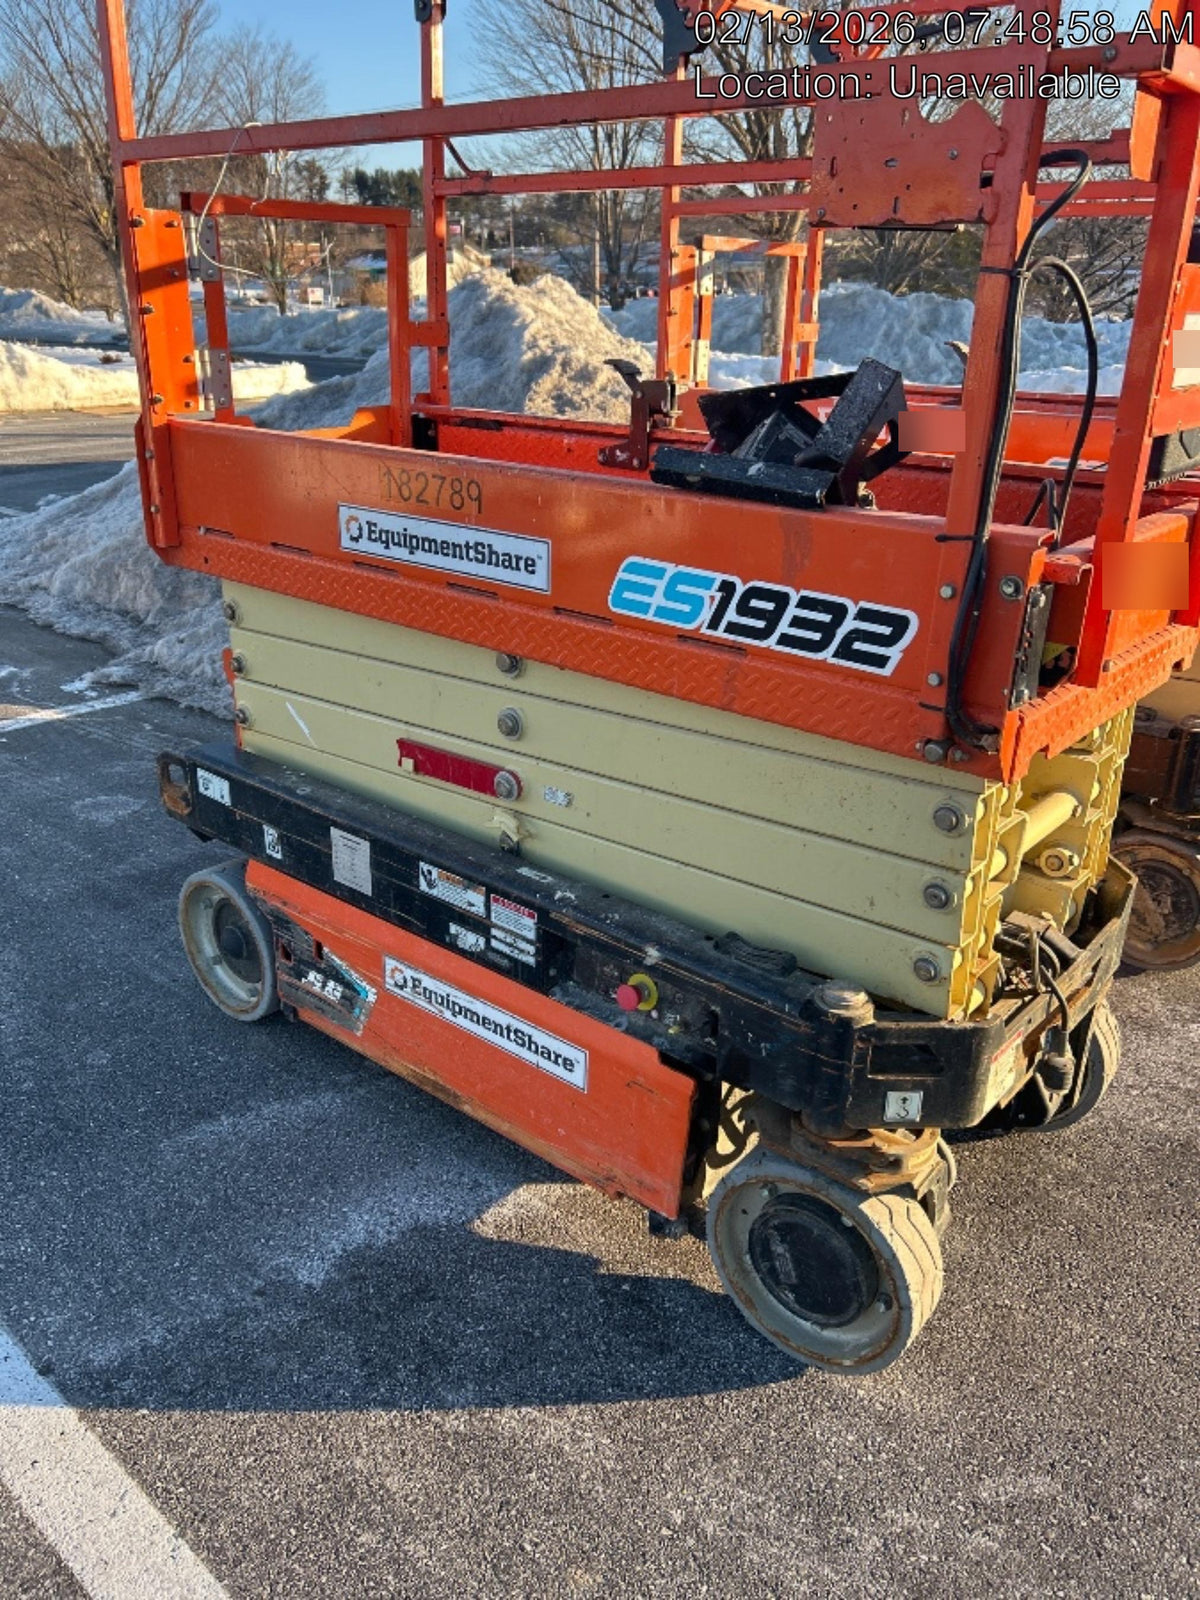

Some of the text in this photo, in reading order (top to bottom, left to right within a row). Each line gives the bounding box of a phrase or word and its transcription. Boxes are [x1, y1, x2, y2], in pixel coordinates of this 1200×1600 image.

[383, 467, 483, 515] 182789
[365, 519, 537, 576] EquipmentShare
[610, 558, 915, 672] ES1932
[409, 975, 576, 1075] EquipmentShare
